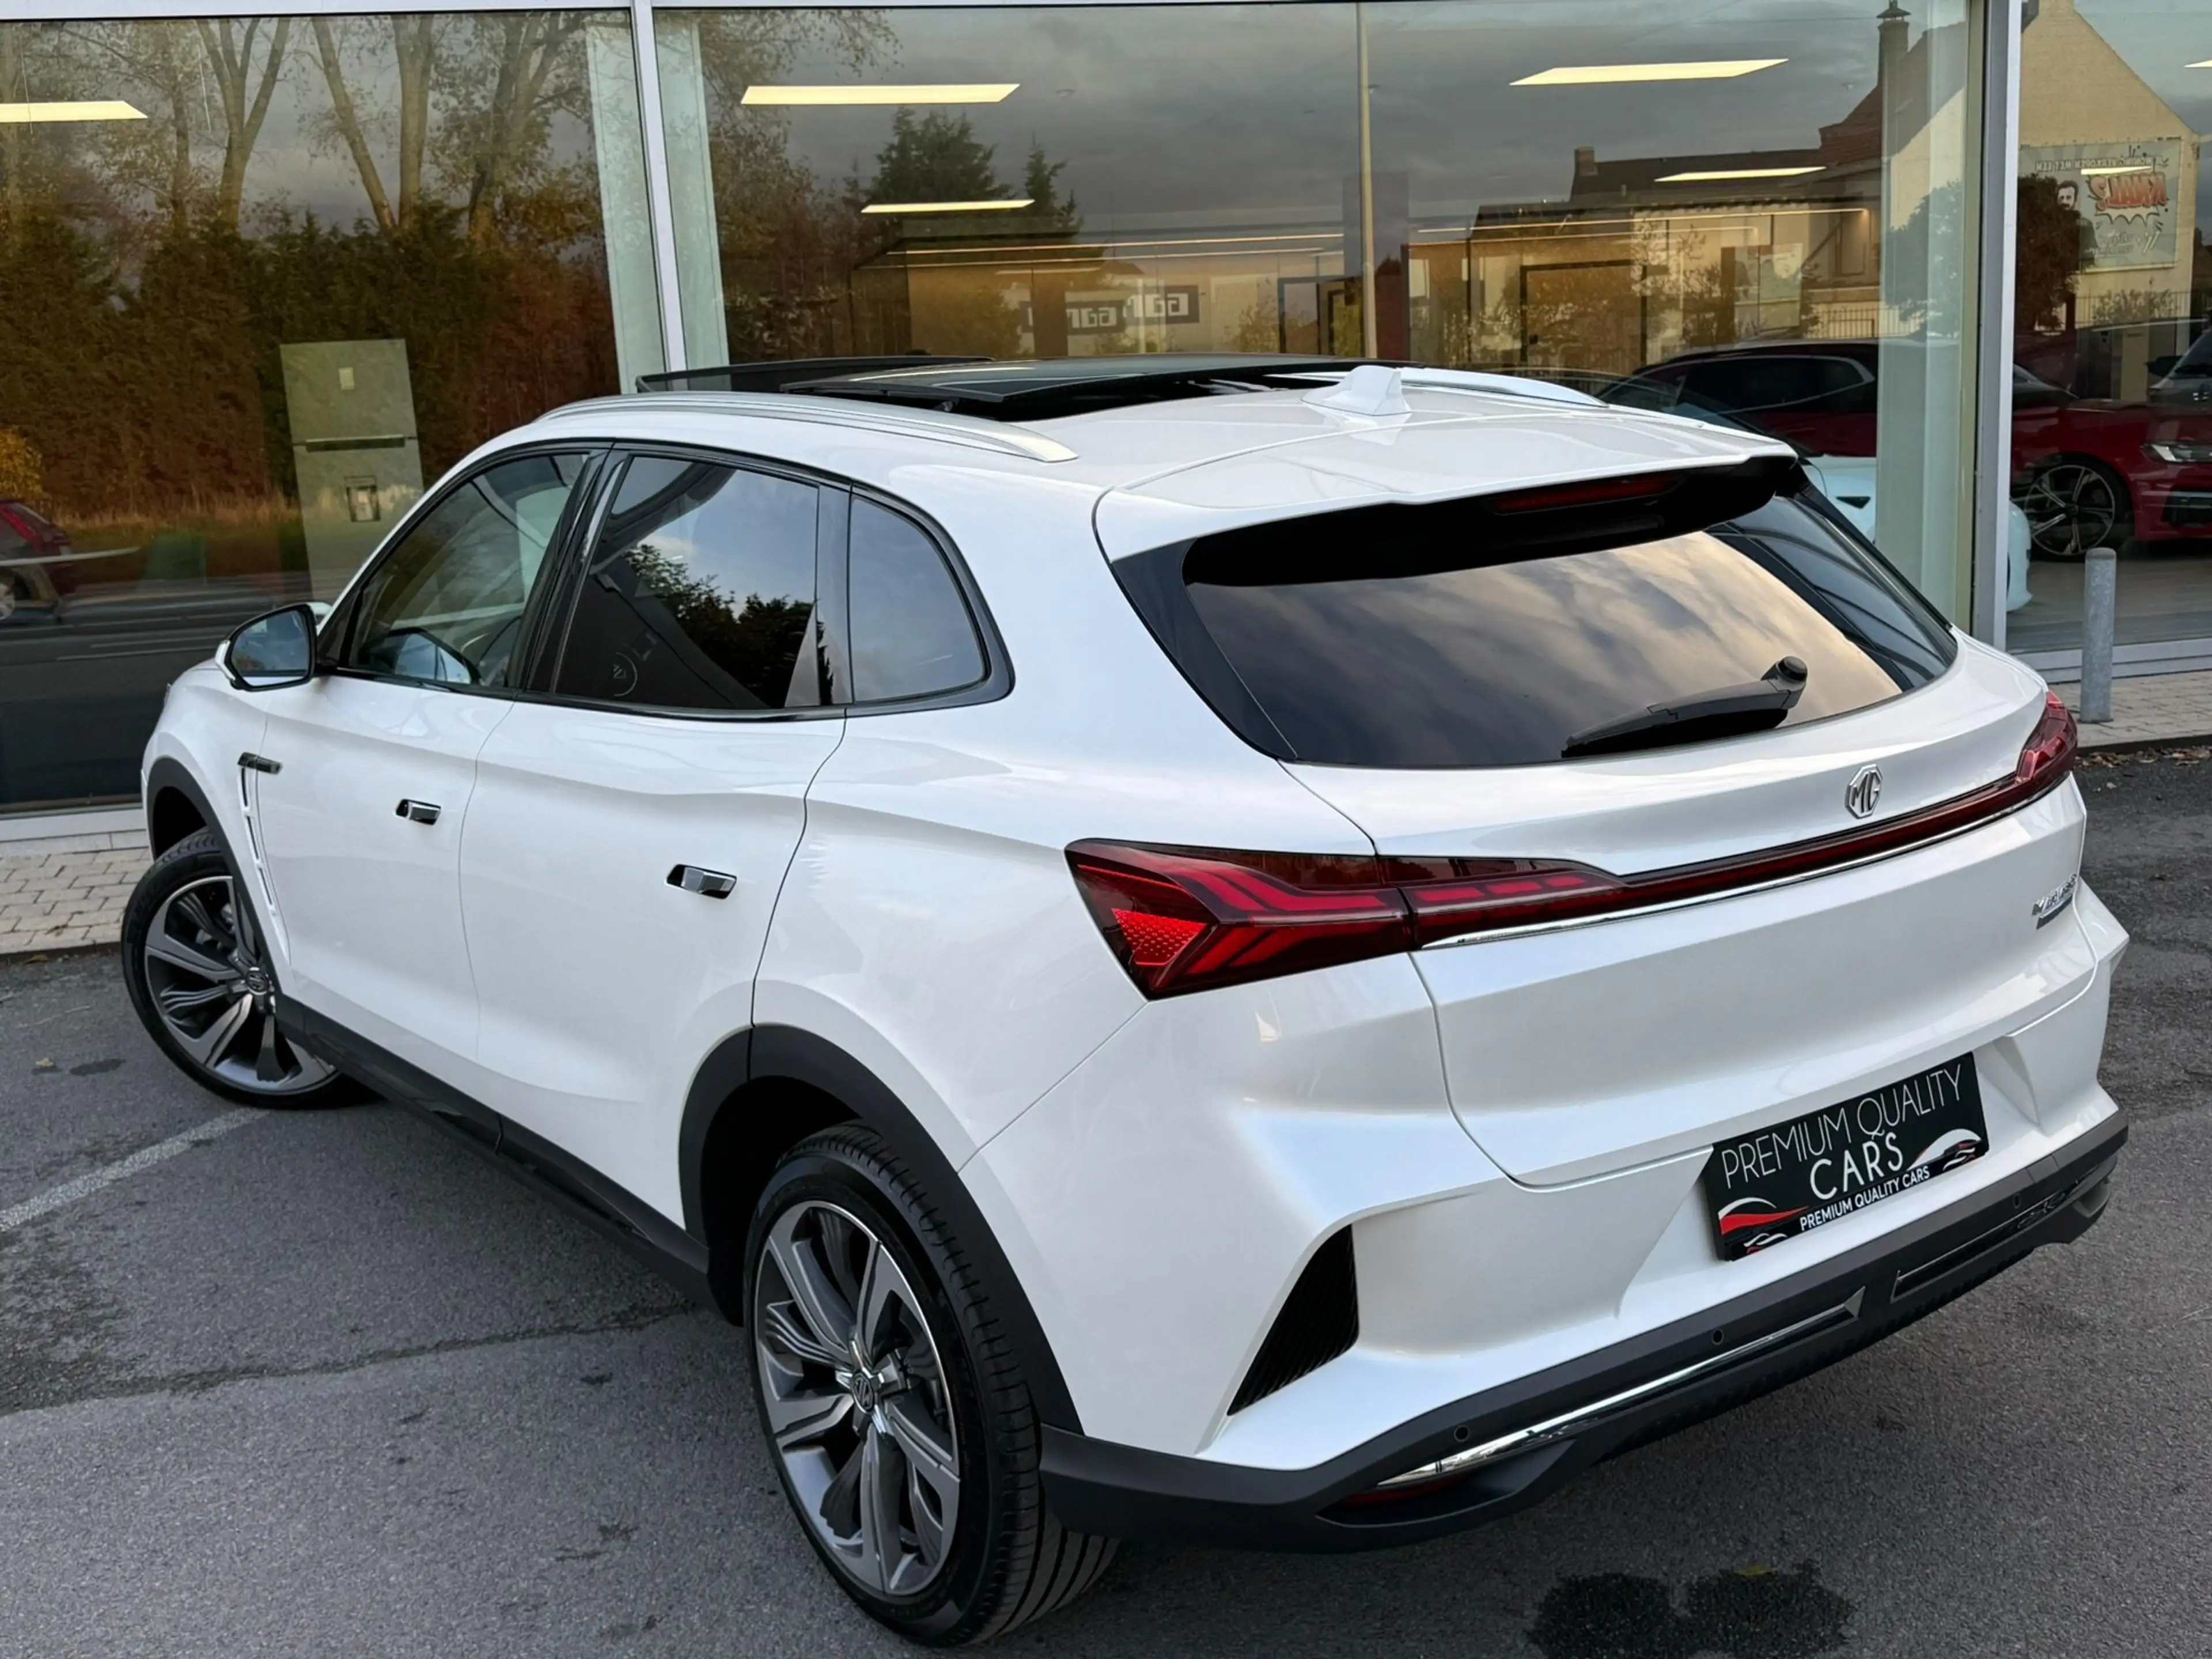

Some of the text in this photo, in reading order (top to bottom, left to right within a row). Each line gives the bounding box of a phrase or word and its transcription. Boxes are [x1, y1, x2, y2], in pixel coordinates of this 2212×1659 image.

[1849, 768, 1882, 816] MG
[1721, 1063, 1961, 1189] PREMIUM QUALITY
[1800, 1165, 1930, 1232] PREMIUM QUALITY CARS
[1810, 1131, 1904, 1200] CARS
